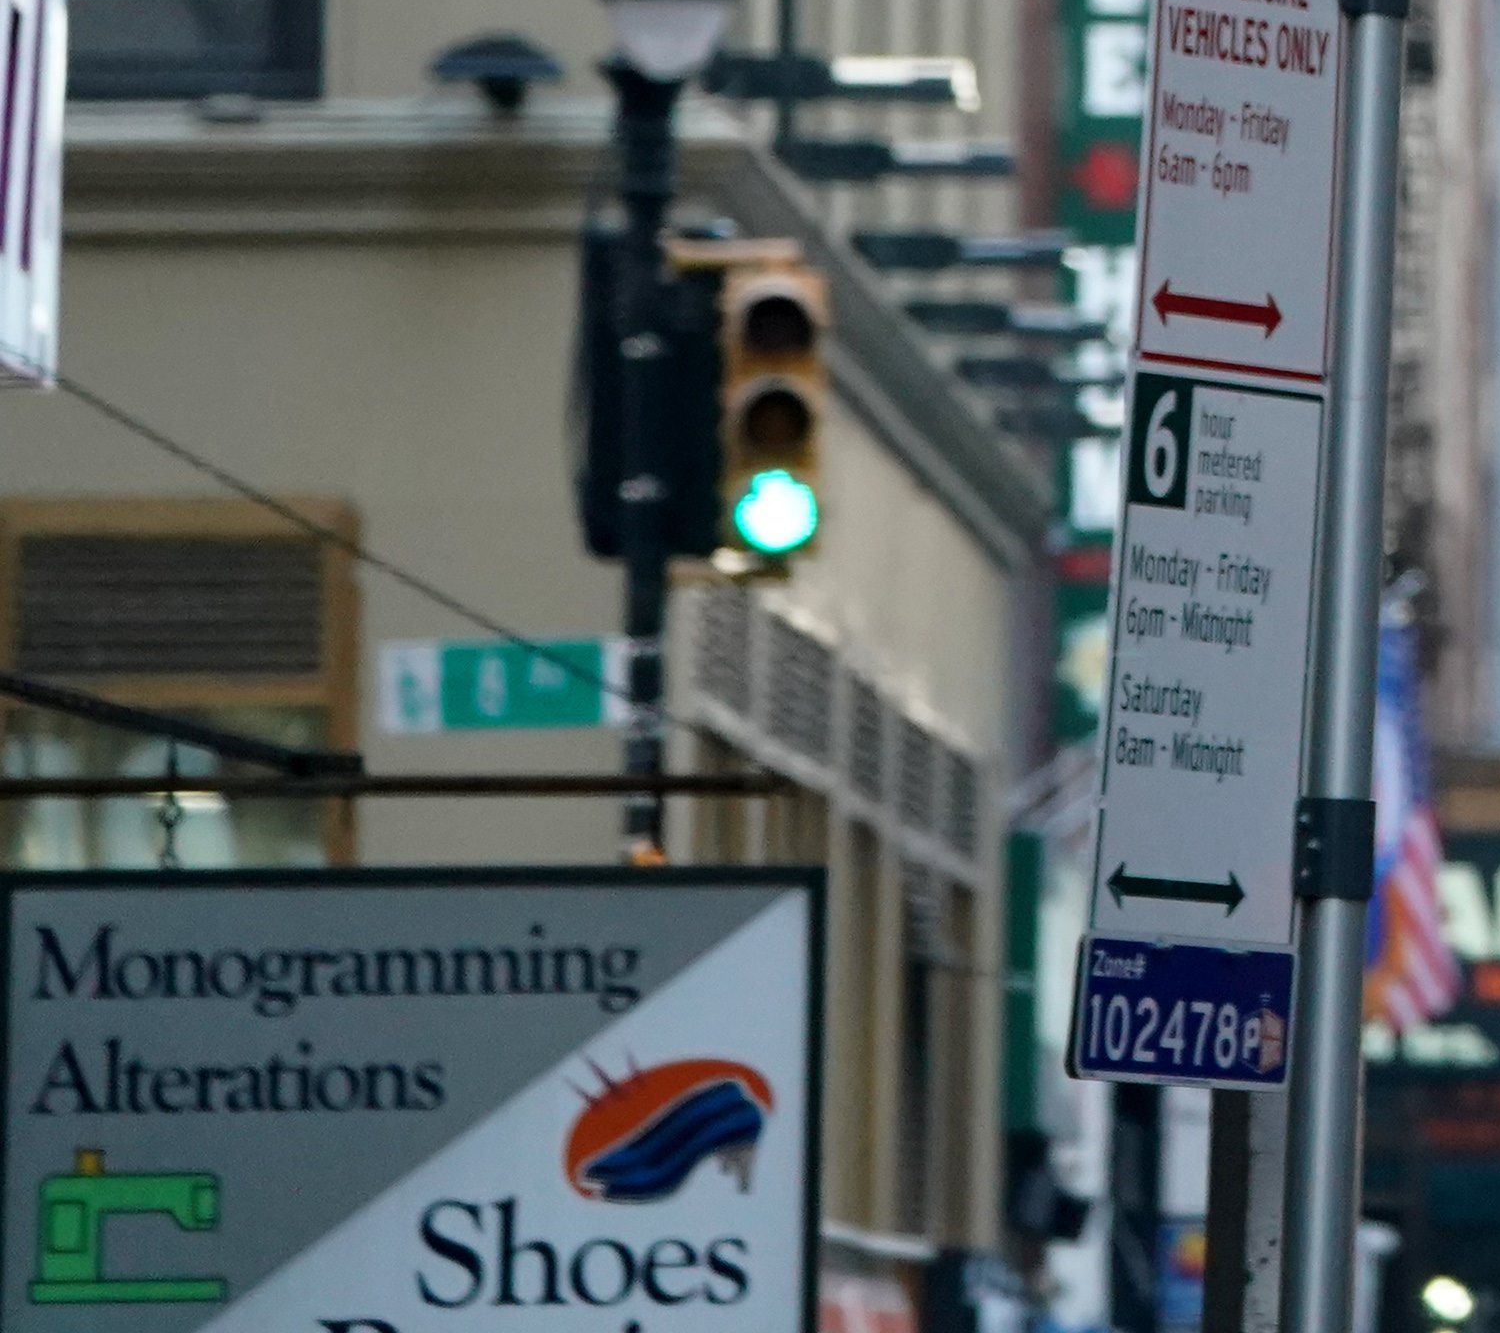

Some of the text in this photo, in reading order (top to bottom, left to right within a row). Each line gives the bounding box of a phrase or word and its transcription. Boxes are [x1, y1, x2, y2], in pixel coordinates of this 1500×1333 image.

[1169, 5, 1330, 76] VEHICLES ONLY
[1161, 90, 1225, 146] Monday
[1240, 101, 1291, 155] Friday
[1159, 144, 1196, 186] 6am
[1212, 150, 1251, 198] 6pm
[1144, 389, 1238, 499] 6 hour
[1199, 445, 1262, 482] metered
[1195, 484, 1253, 526] parking
[1129, 544, 1200, 597] Monday
[1216, 552, 1272, 606] Friday
[1126, 596, 1165, 644] 6pm
[1180, 601, 1254, 655] Midnight
[1120, 672, 1203, 728] Saturday
[1115, 726, 1154, 769] 8am
[1171, 731, 1244, 784] Midnight
[32, 925, 642, 1015] Monogramming
[1092, 948, 1147, 980] Zone#
[1088, 993, 1240, 1070] 102478
[29, 1038, 446, 1116] Alterations
[415, 1196, 752, 1309] Shoes
